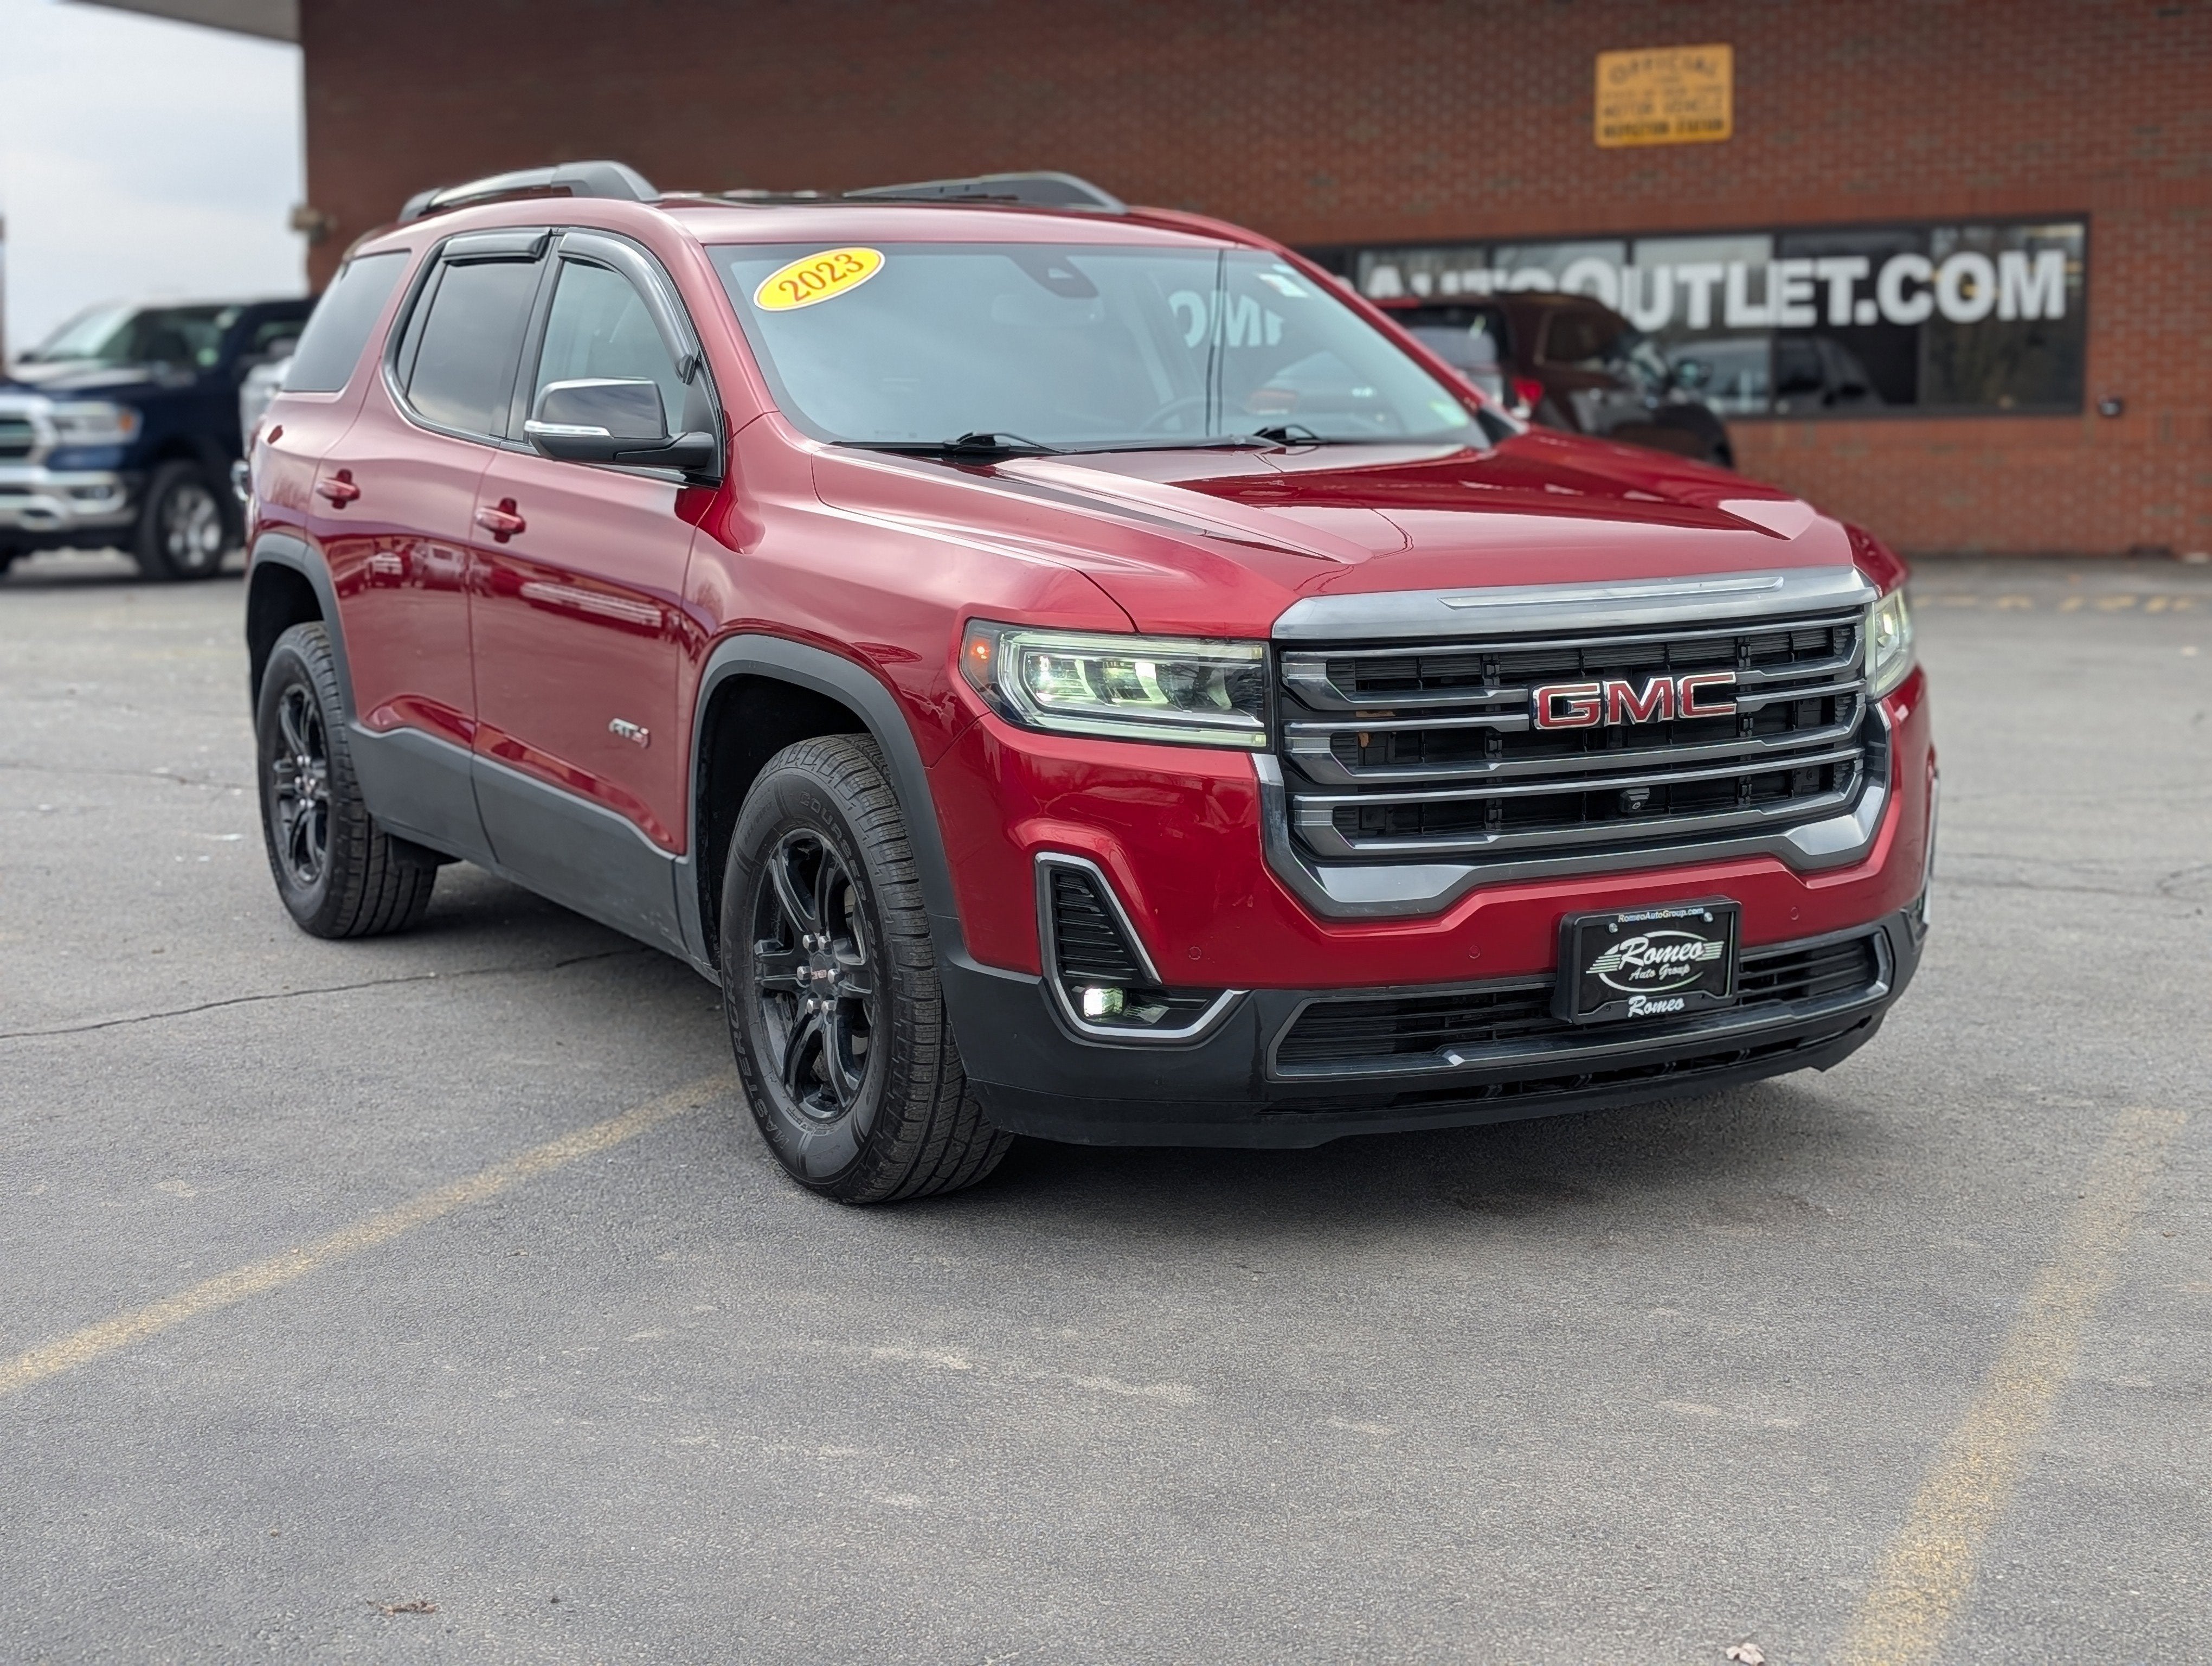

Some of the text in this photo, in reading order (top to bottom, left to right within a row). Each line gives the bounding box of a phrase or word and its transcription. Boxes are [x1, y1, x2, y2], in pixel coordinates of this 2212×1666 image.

[779, 253, 864, 302] 2023
[1533, 672, 1737, 729] GMC
[800, 791, 866, 901] COURSER
[1618, 907, 1704, 922] RomeoAutoGroup.com
[1618, 937, 1704, 970] Romeo
[1629, 964, 1690, 981] Auto Group
[1628, 995, 1684, 1017] Romeo
